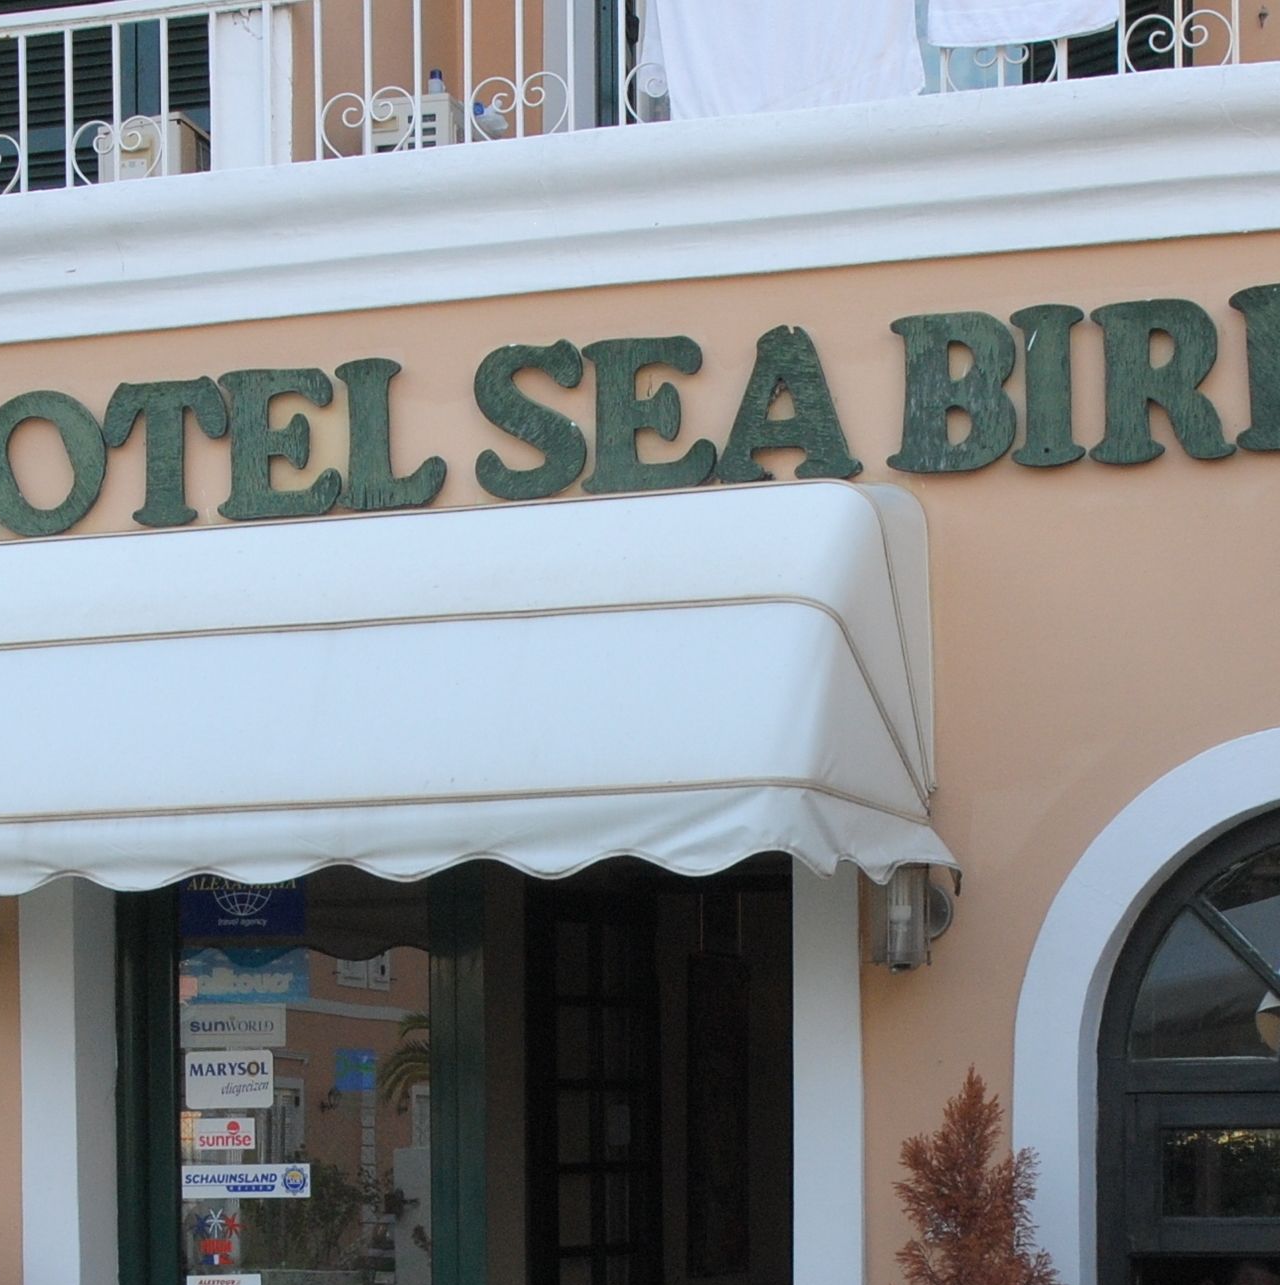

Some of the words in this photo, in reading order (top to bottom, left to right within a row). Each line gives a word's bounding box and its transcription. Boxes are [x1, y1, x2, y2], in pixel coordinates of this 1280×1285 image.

[474, 324, 864, 500] SEA
[189, 1061, 269, 1077] MARYSOL
[199, 1131, 252, 1147] sunrise
[184, 1173, 278, 1184] SCHAUINSLAND
